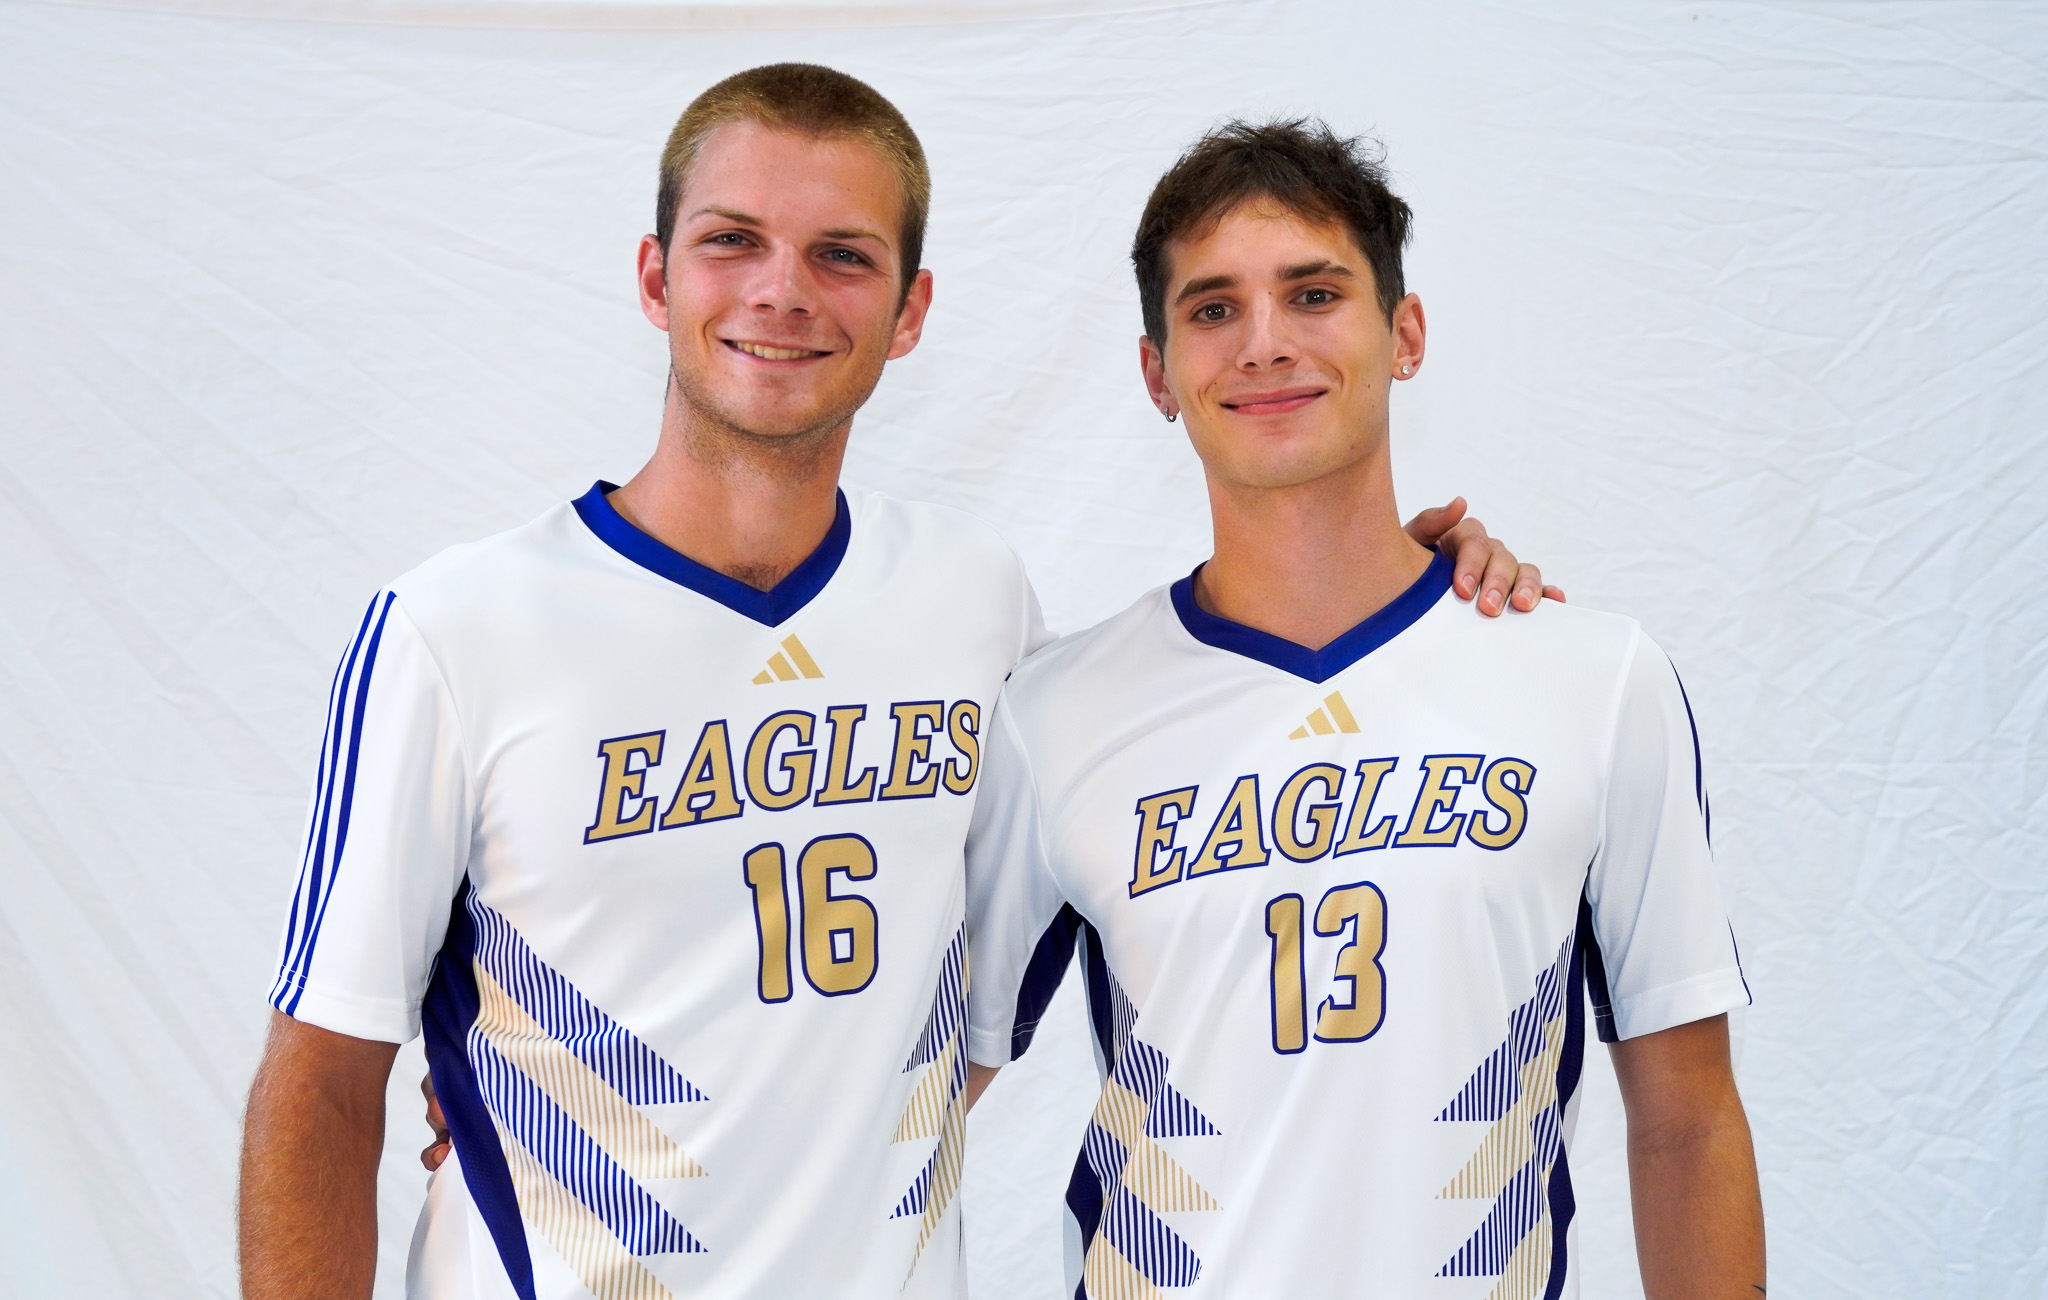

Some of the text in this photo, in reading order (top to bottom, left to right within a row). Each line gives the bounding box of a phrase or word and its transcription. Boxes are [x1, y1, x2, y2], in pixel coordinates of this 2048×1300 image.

[583, 699, 981, 845] EAGLES
[1128, 754, 1537, 899] EAGLES
[743, 833, 879, 1004] 16
[1265, 880, 1388, 1055] 13
